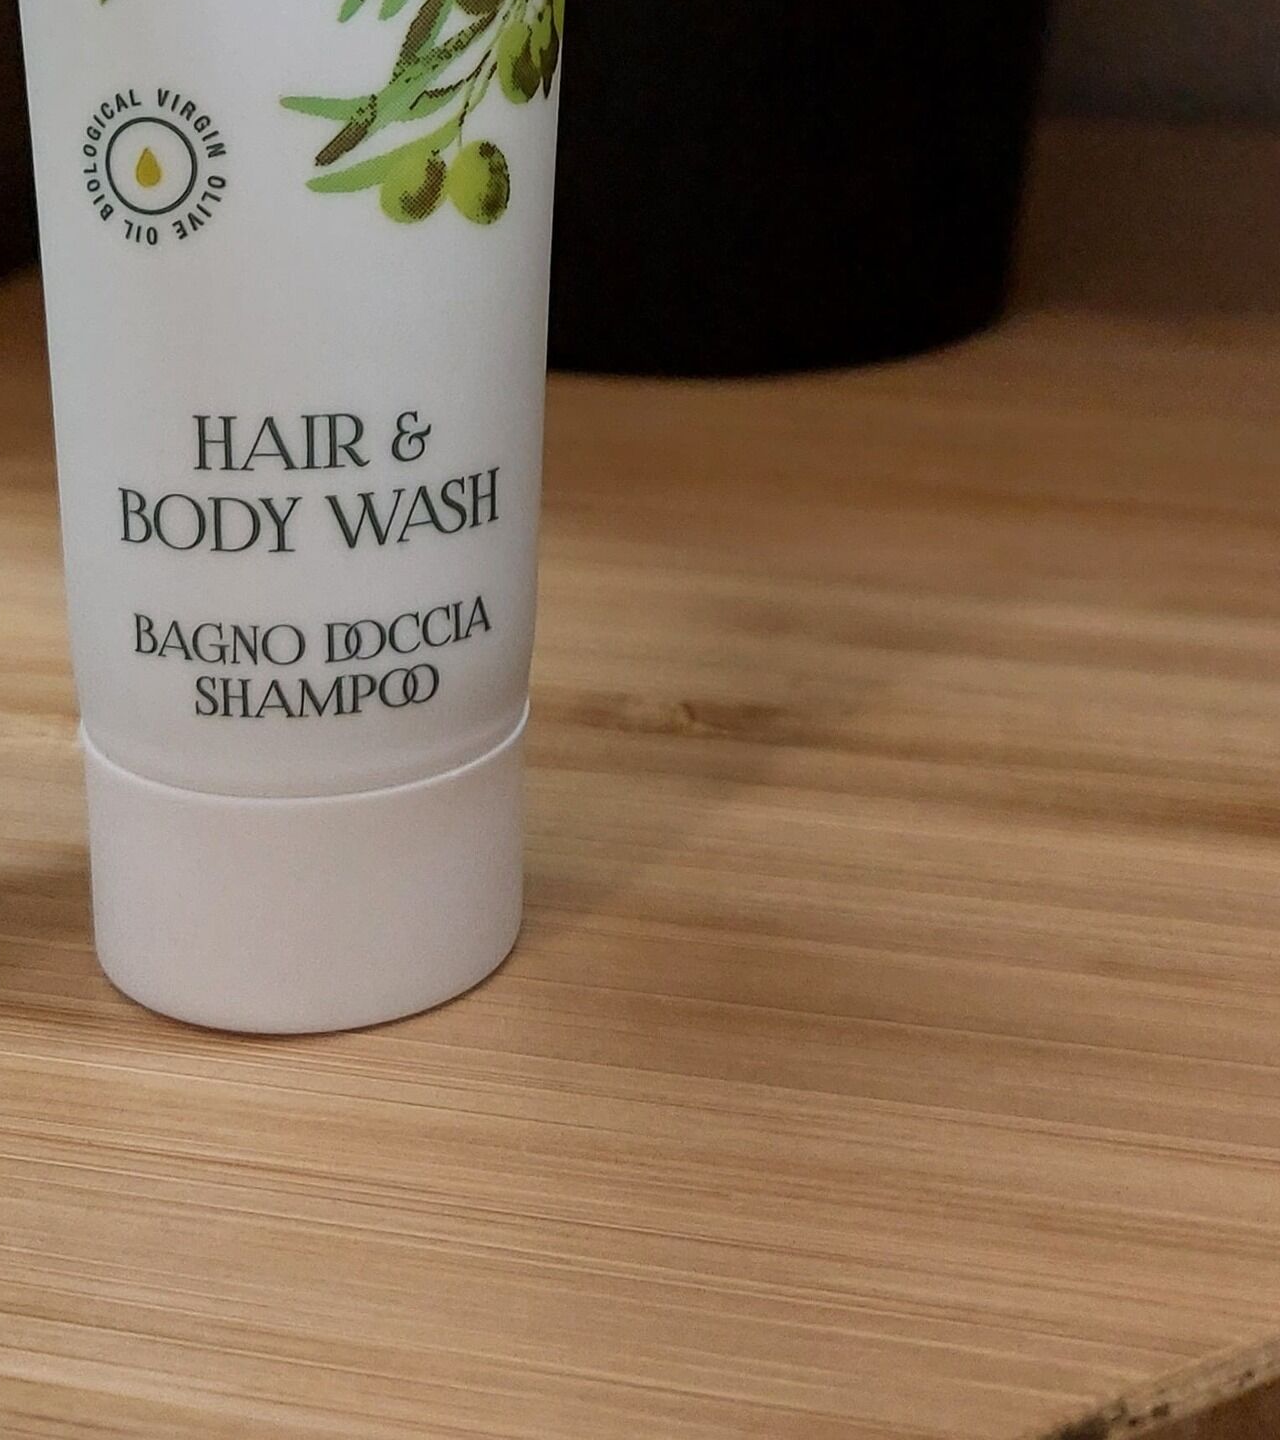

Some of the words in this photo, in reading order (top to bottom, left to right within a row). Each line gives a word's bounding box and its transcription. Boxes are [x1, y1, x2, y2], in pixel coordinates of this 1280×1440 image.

[82, 88, 141, 222] BIOLOGICAL
[157, 88, 227, 158] VIRGIN
[124, 219, 158, 245] OIL
[172, 175, 227, 240] OLIVE
[192, 412, 371, 471] HAIR
[391, 410, 432, 462] &
[118, 486, 303, 554] BODY
[325, 467, 501, 549] WASH
[133, 612, 306, 666] BAGNO
[324, 595, 492, 664] DOCCIA
[194, 663, 440, 719] SHAMPOO
